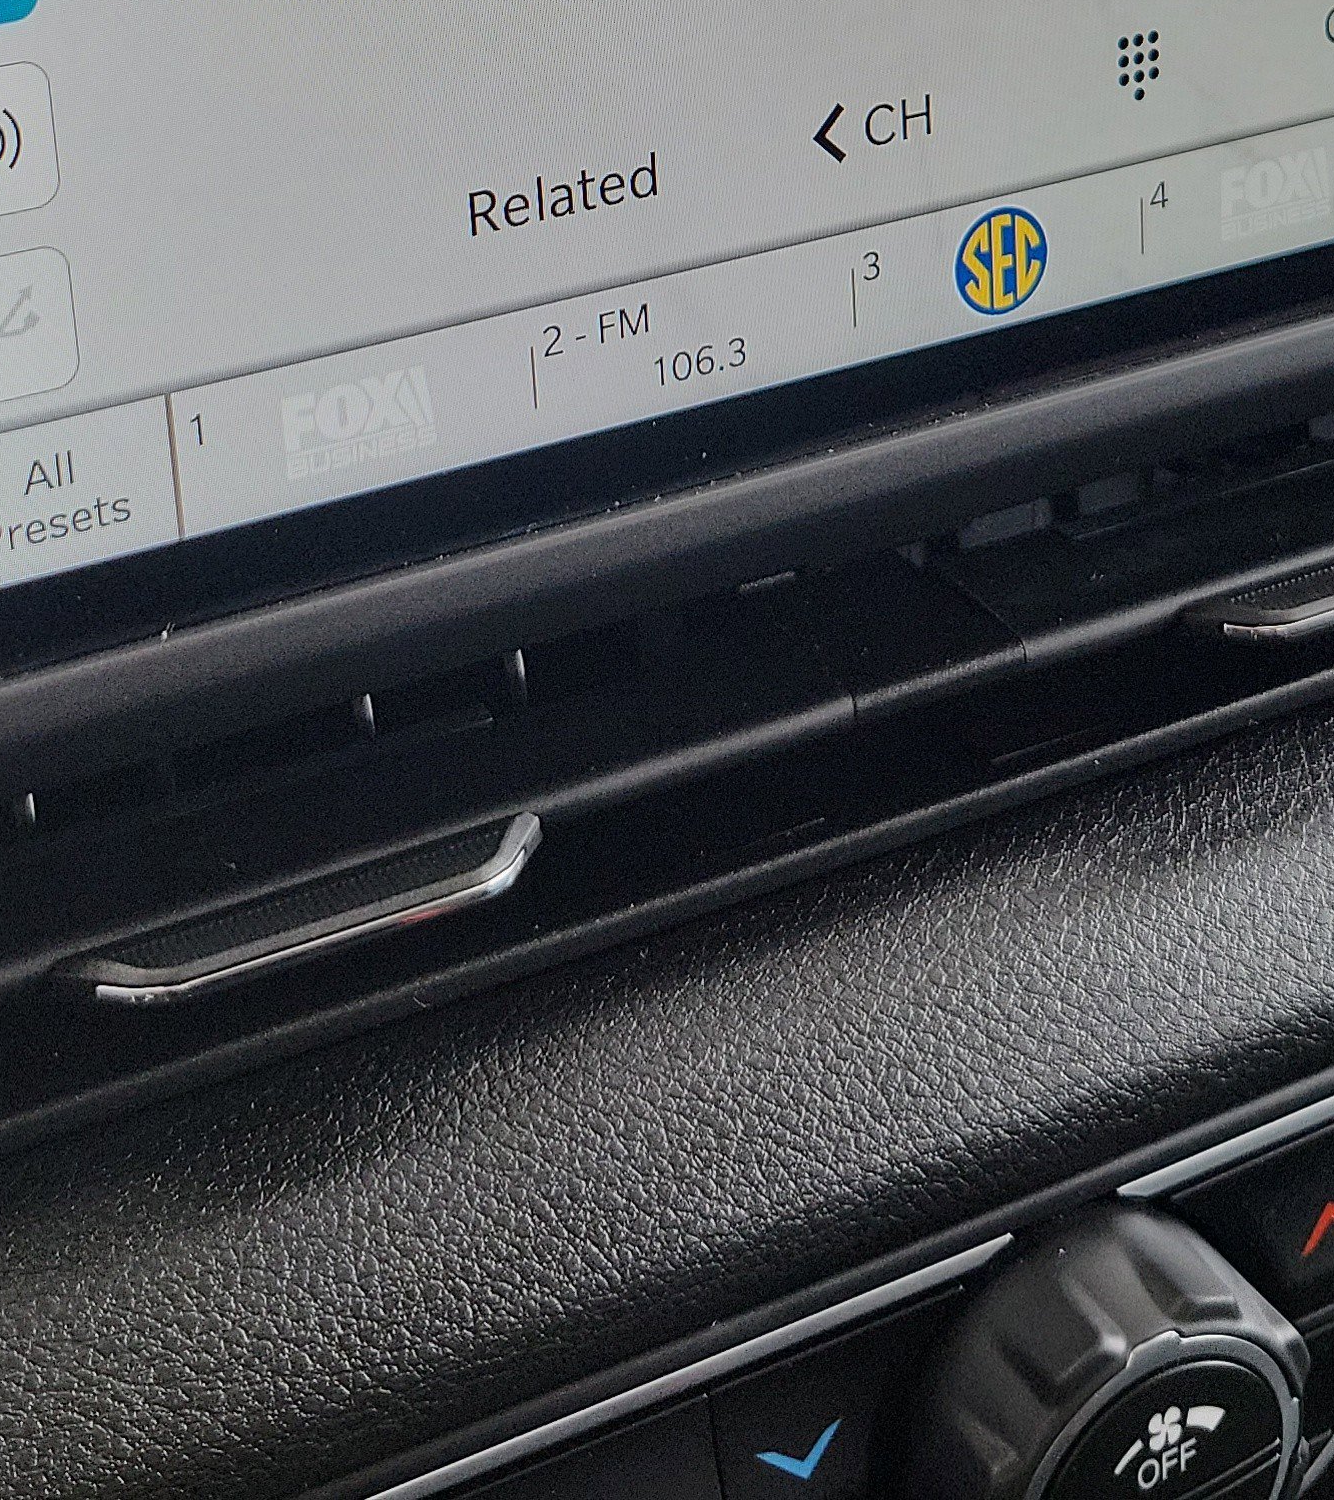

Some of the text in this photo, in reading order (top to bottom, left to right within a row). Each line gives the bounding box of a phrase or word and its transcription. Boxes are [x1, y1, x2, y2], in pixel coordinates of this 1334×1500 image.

[864, 93, 934, 147] CH
[468, 152, 659, 237] Related
[1150, 181, 1169, 211] 4
[862, 251, 881, 281] 3
[963, 212, 1043, 311] SEC
[544, 325, 563, 359] 2
[599, 303, 652, 346] FM
[654, 336, 748, 389] 106.3
[190, 413, 204, 447] 1
[23, 450, 75, 496] All
[287, 432, 439, 479] BUSINESS
[1138, 1445, 1195, 1491] OFF
